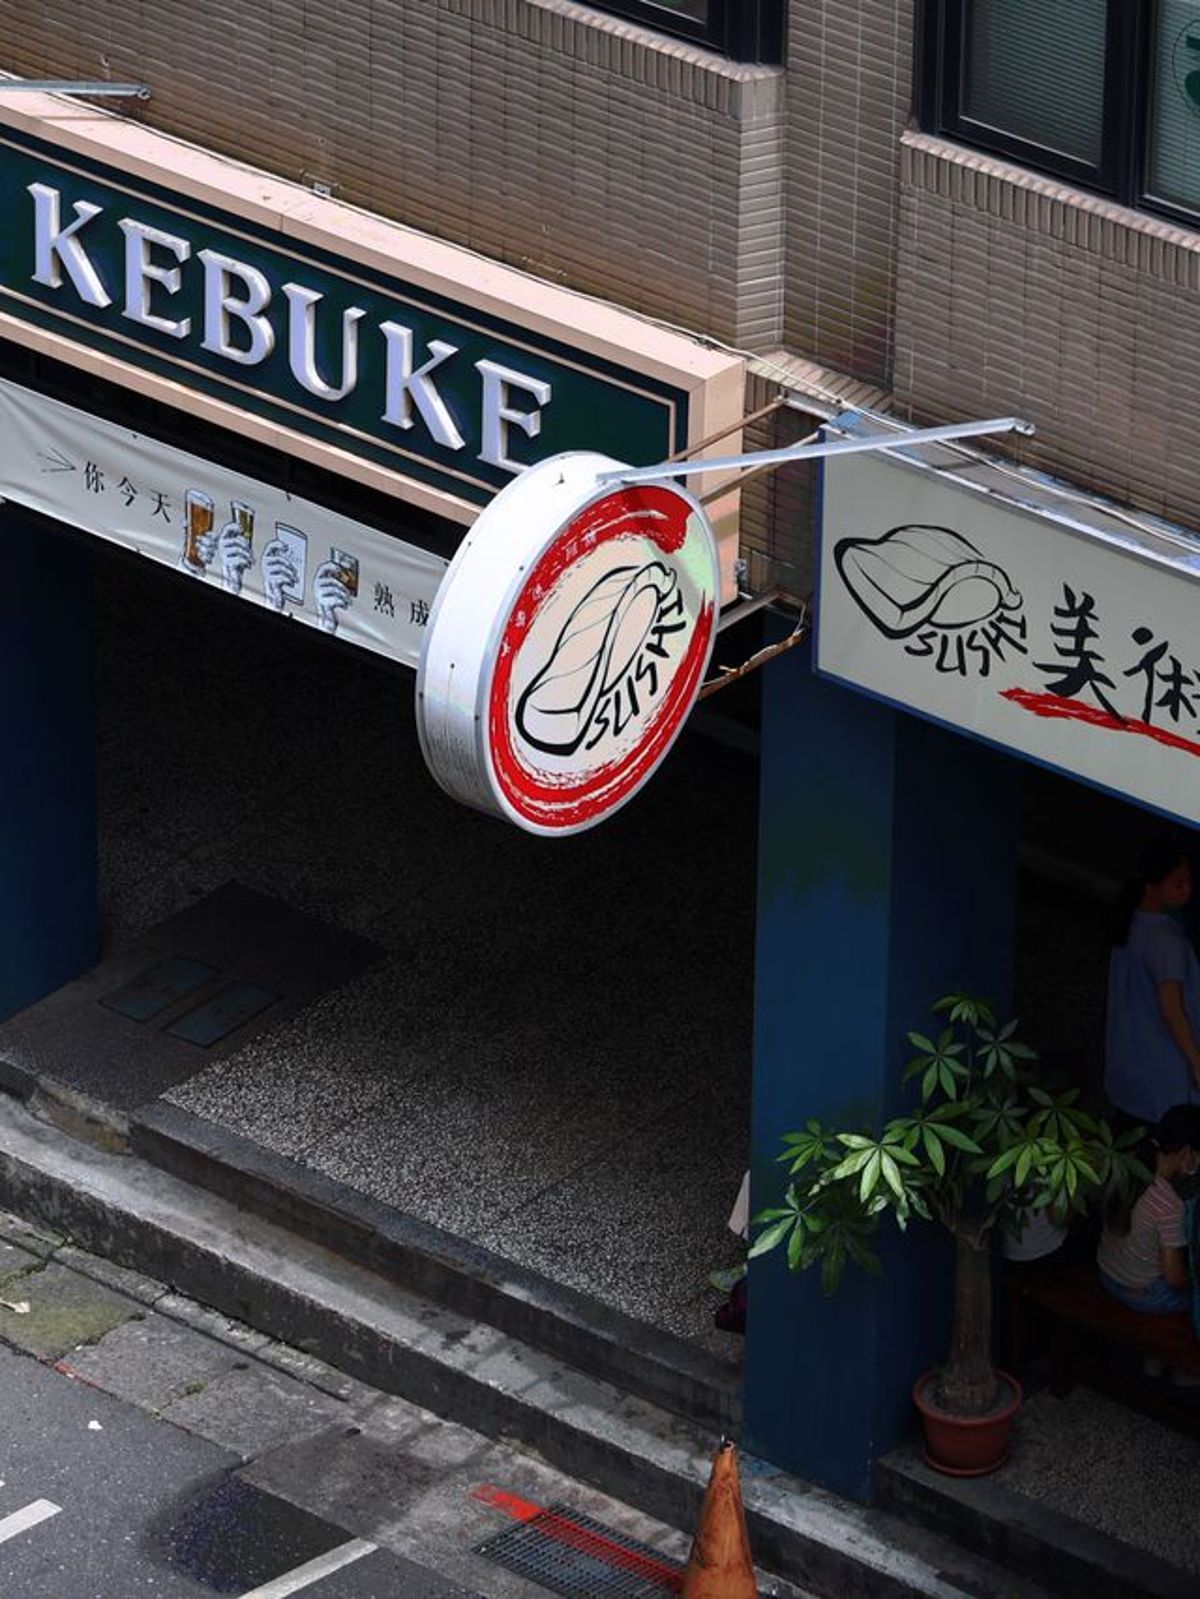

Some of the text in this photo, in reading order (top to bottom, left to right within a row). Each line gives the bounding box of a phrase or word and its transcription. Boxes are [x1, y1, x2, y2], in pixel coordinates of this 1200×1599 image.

[27, 182, 552, 474] KEBUKE
[85, 461, 172, 524] 你今天
[584, 588, 687, 751] SUSHI
[903, 610, 1029, 677] SUSHI
